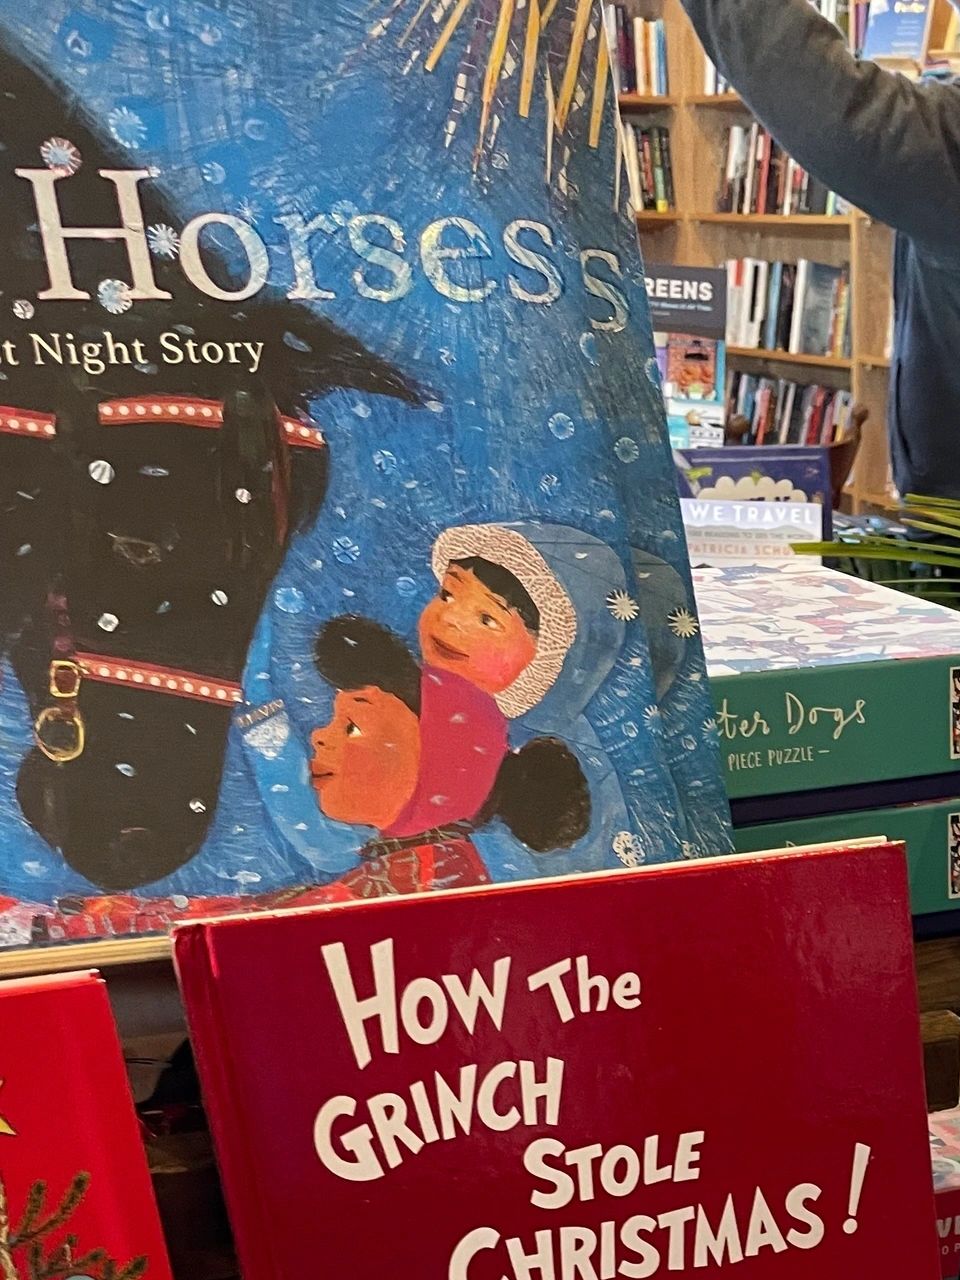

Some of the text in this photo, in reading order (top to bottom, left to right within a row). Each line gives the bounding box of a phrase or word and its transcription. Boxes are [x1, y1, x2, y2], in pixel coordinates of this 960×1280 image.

[15, 165, 564, 304] Horses
[29, 332, 148, 375] Night
[159, 332, 264, 373] Story
[732, 504, 813, 525] TRAVEL
[785, 692, 866, 740] Dogs
[728, 744, 814, 771] PIECE PUZZLE
[527, 955, 642, 1023] The
[313, 1056, 565, 1182] GRINCH
[522, 1130, 705, 1210] STOLE
